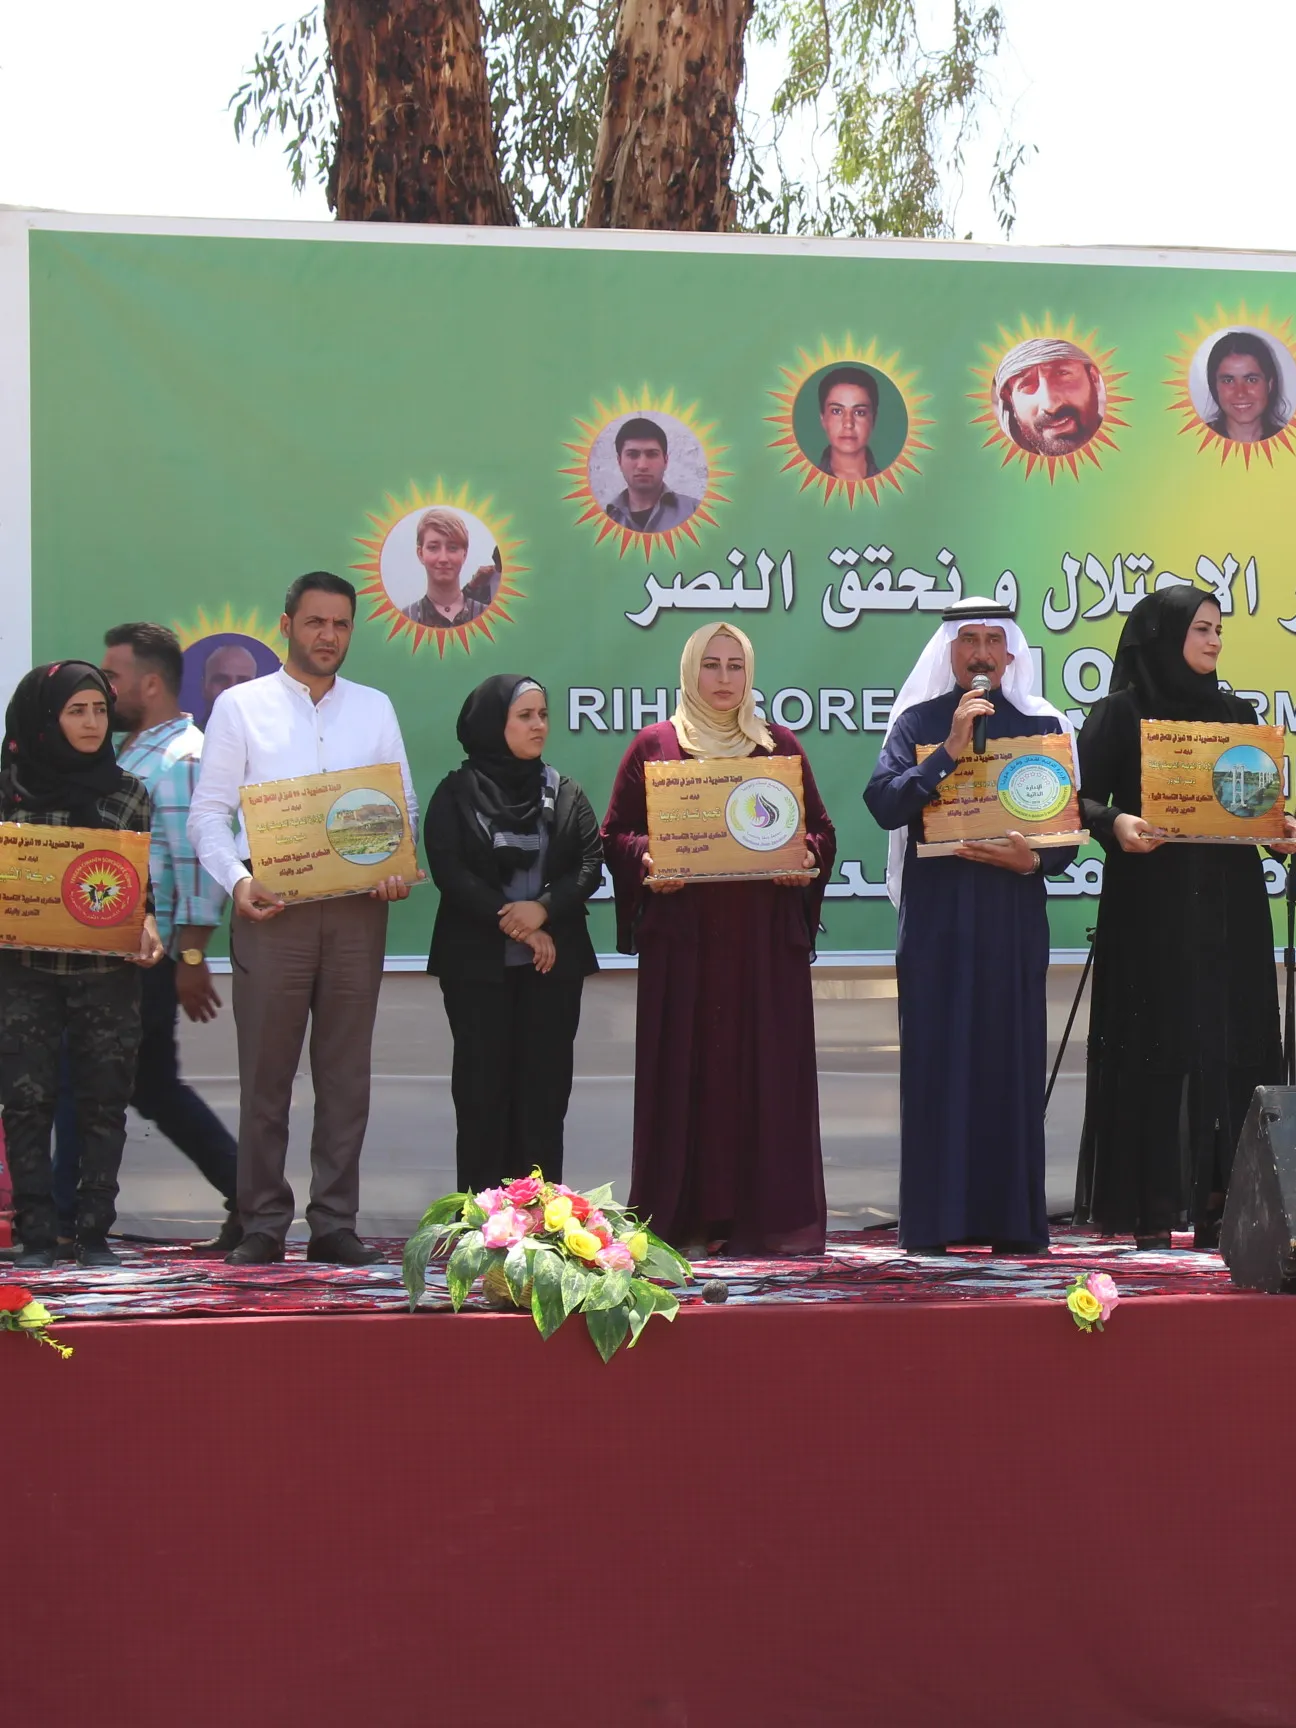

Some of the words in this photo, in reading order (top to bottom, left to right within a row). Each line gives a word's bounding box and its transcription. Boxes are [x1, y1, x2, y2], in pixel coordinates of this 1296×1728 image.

[624, 546, 794, 628] النصر
[821, 543, 963, 629] نحقق
[993, 569, 1018, 613] و
[568, 687, 681, 730] RIH
